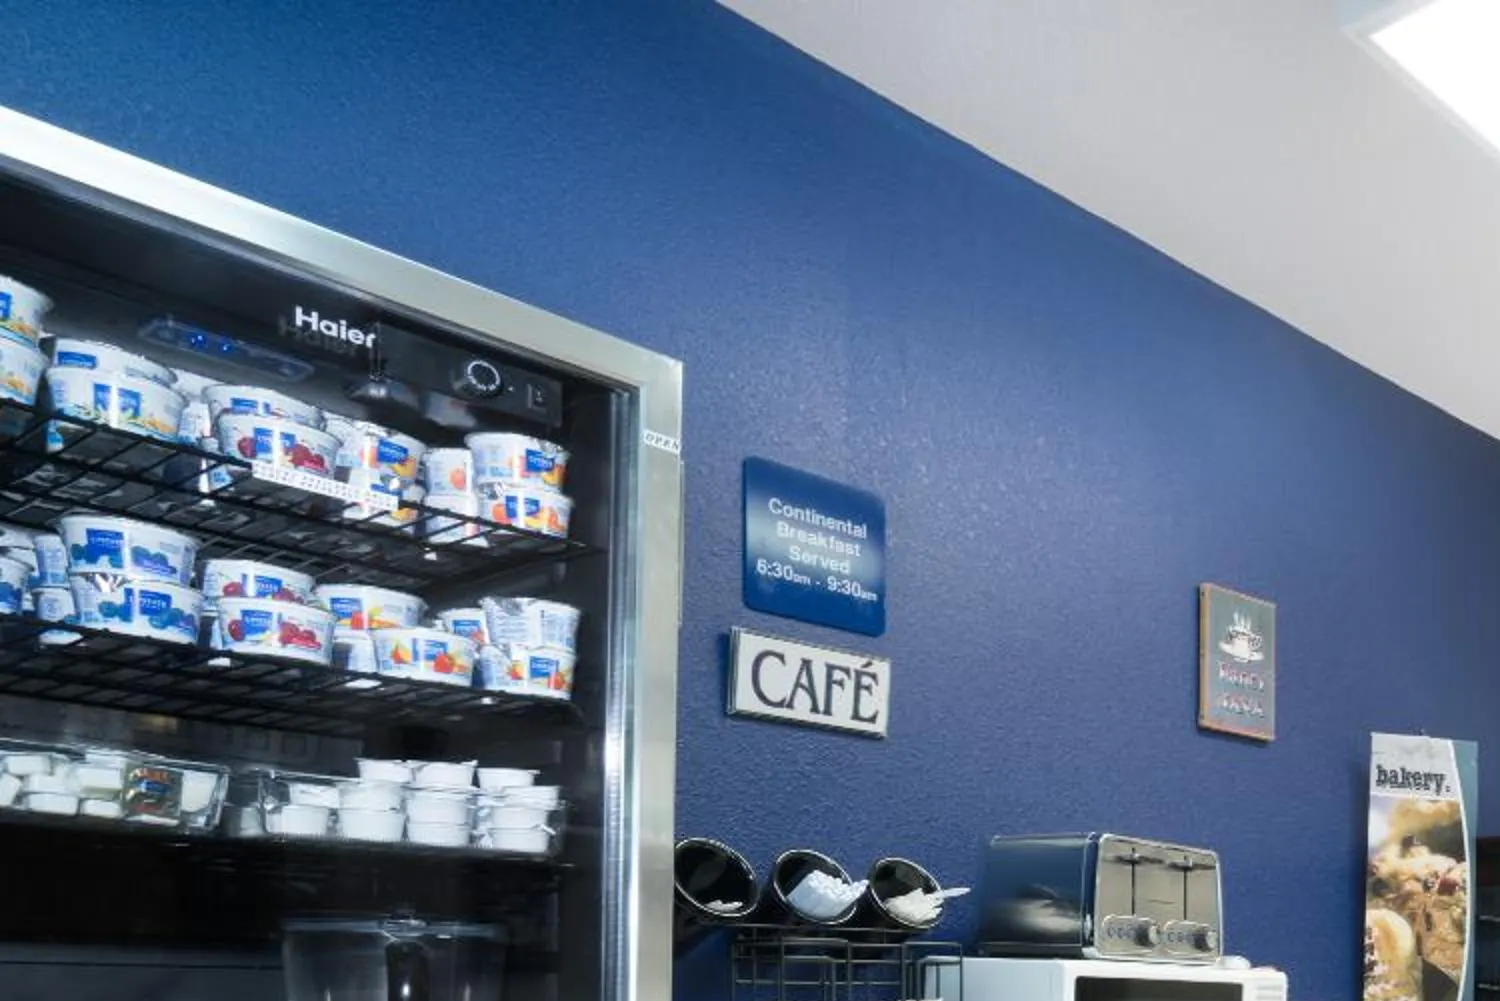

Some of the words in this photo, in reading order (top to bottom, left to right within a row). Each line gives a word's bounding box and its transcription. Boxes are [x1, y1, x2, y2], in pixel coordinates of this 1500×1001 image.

[295, 305, 376, 349] Haier
[768, 497, 867, 539] Continental
[777, 520, 861, 557] Breakfast
[756, 557, 811, 586] 6:30am
[827, 575, 878, 602] 9:30am
[789, 545, 850, 575] Served
[751, 650, 879, 724] CAFÉ
